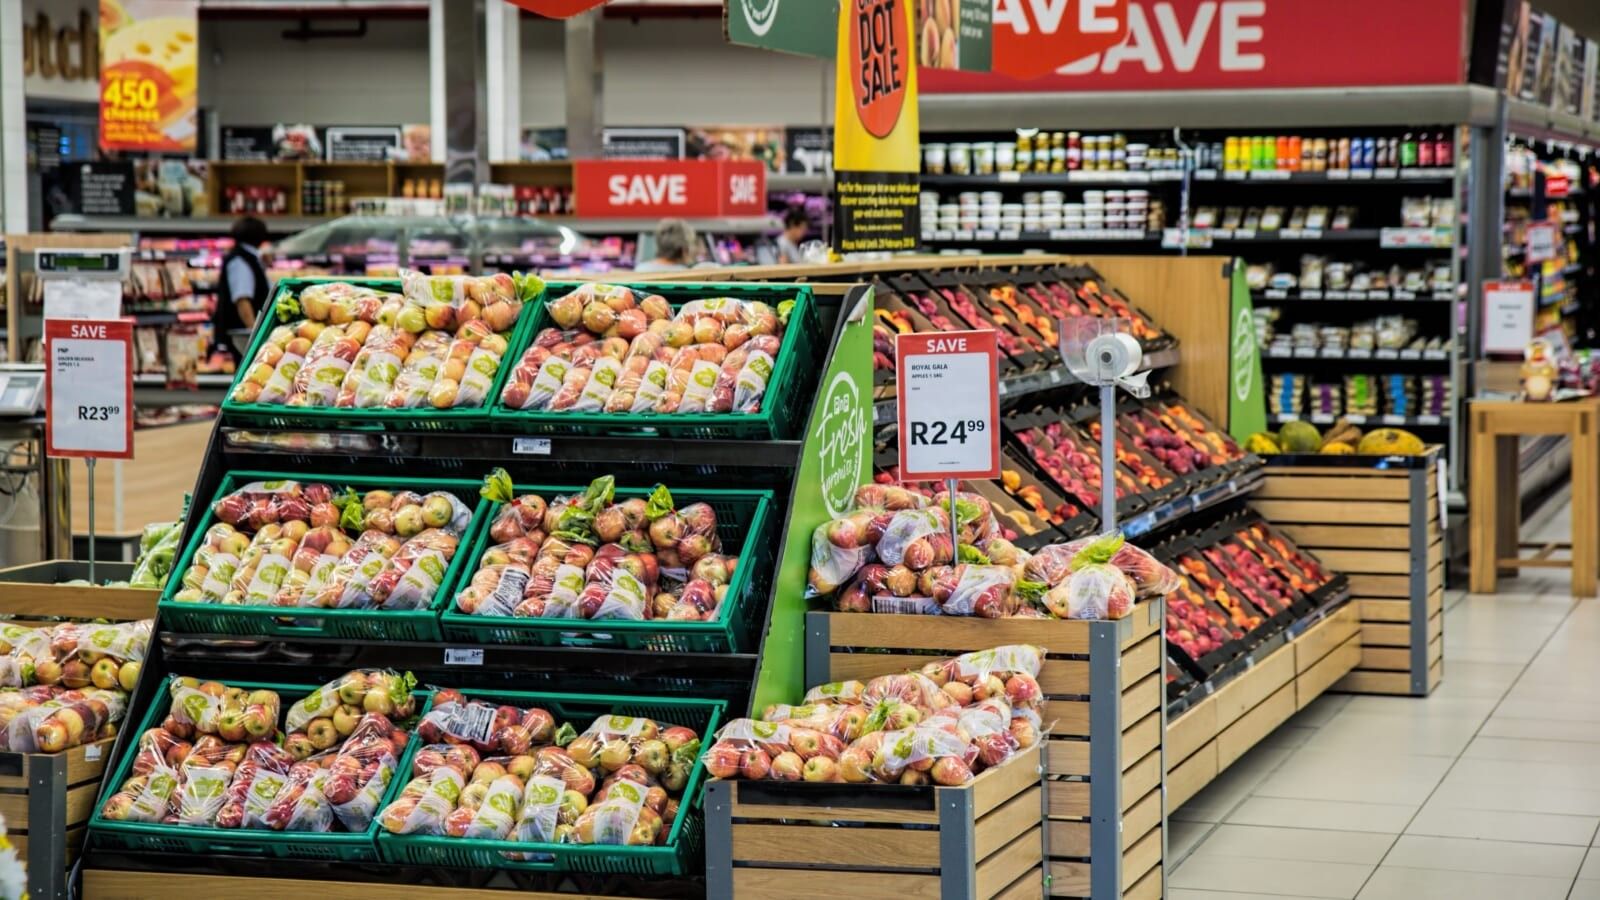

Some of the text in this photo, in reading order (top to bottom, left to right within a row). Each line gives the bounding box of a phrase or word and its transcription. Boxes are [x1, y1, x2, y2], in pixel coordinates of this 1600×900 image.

[857, 2, 895, 61] DOT
[1055, 1, 1266, 74] AVE
[103, 80, 159, 108] 450
[861, 48, 901, 106] SALE
[608, 174, 687, 206] SAVE
[71, 325, 107, 338] SAVE
[927, 338, 967, 353] SAVE
[815, 386, 868, 468] Fresh
